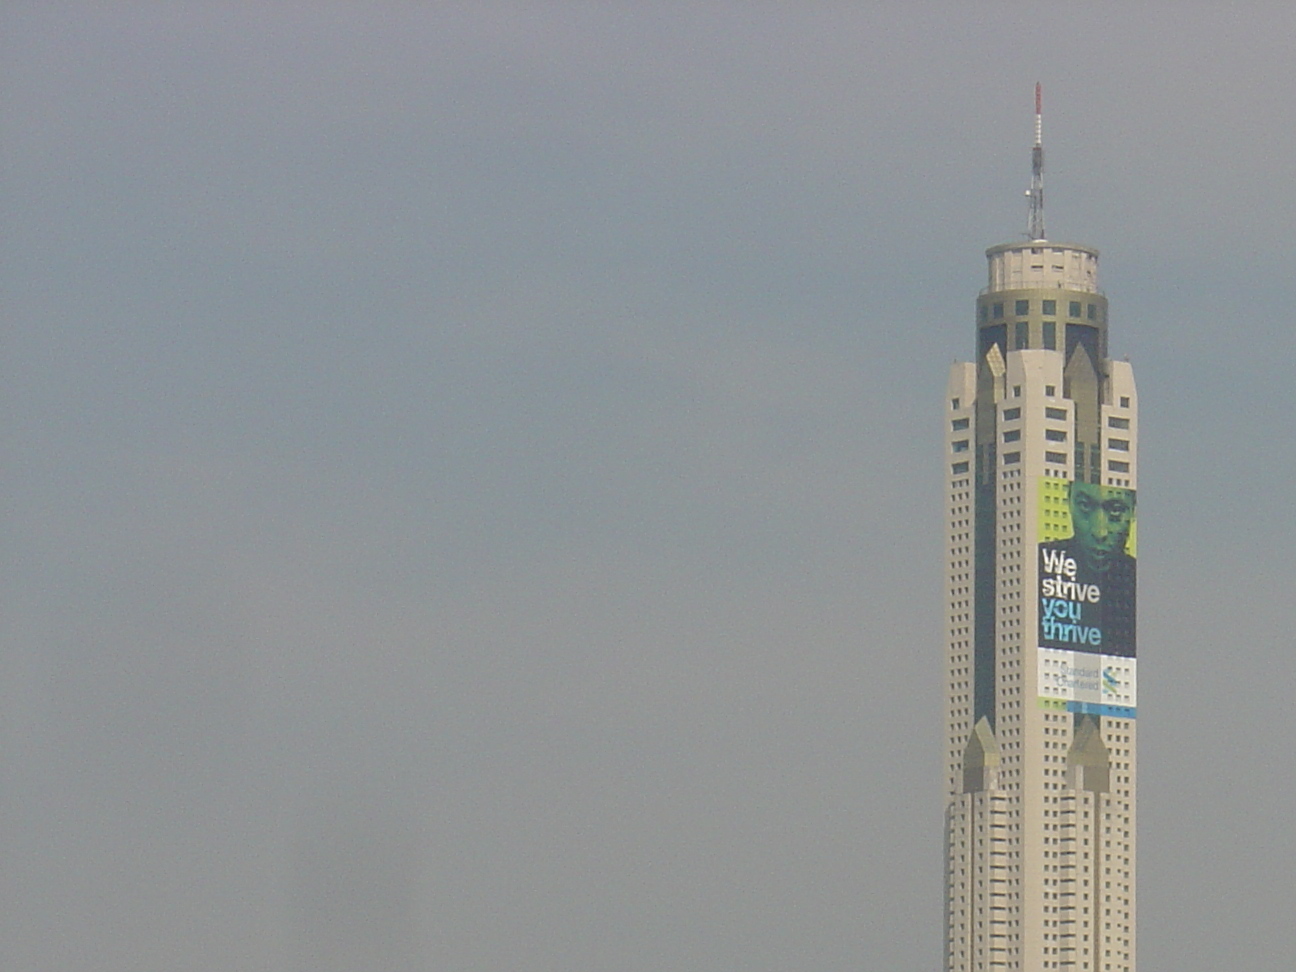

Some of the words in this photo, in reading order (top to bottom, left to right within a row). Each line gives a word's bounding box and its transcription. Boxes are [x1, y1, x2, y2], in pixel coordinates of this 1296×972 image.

[1042, 548, 1077, 576] We
[1042, 575, 1100, 603] strive
[1042, 598, 1081, 621] you
[1042, 616, 1102, 645] thrive
